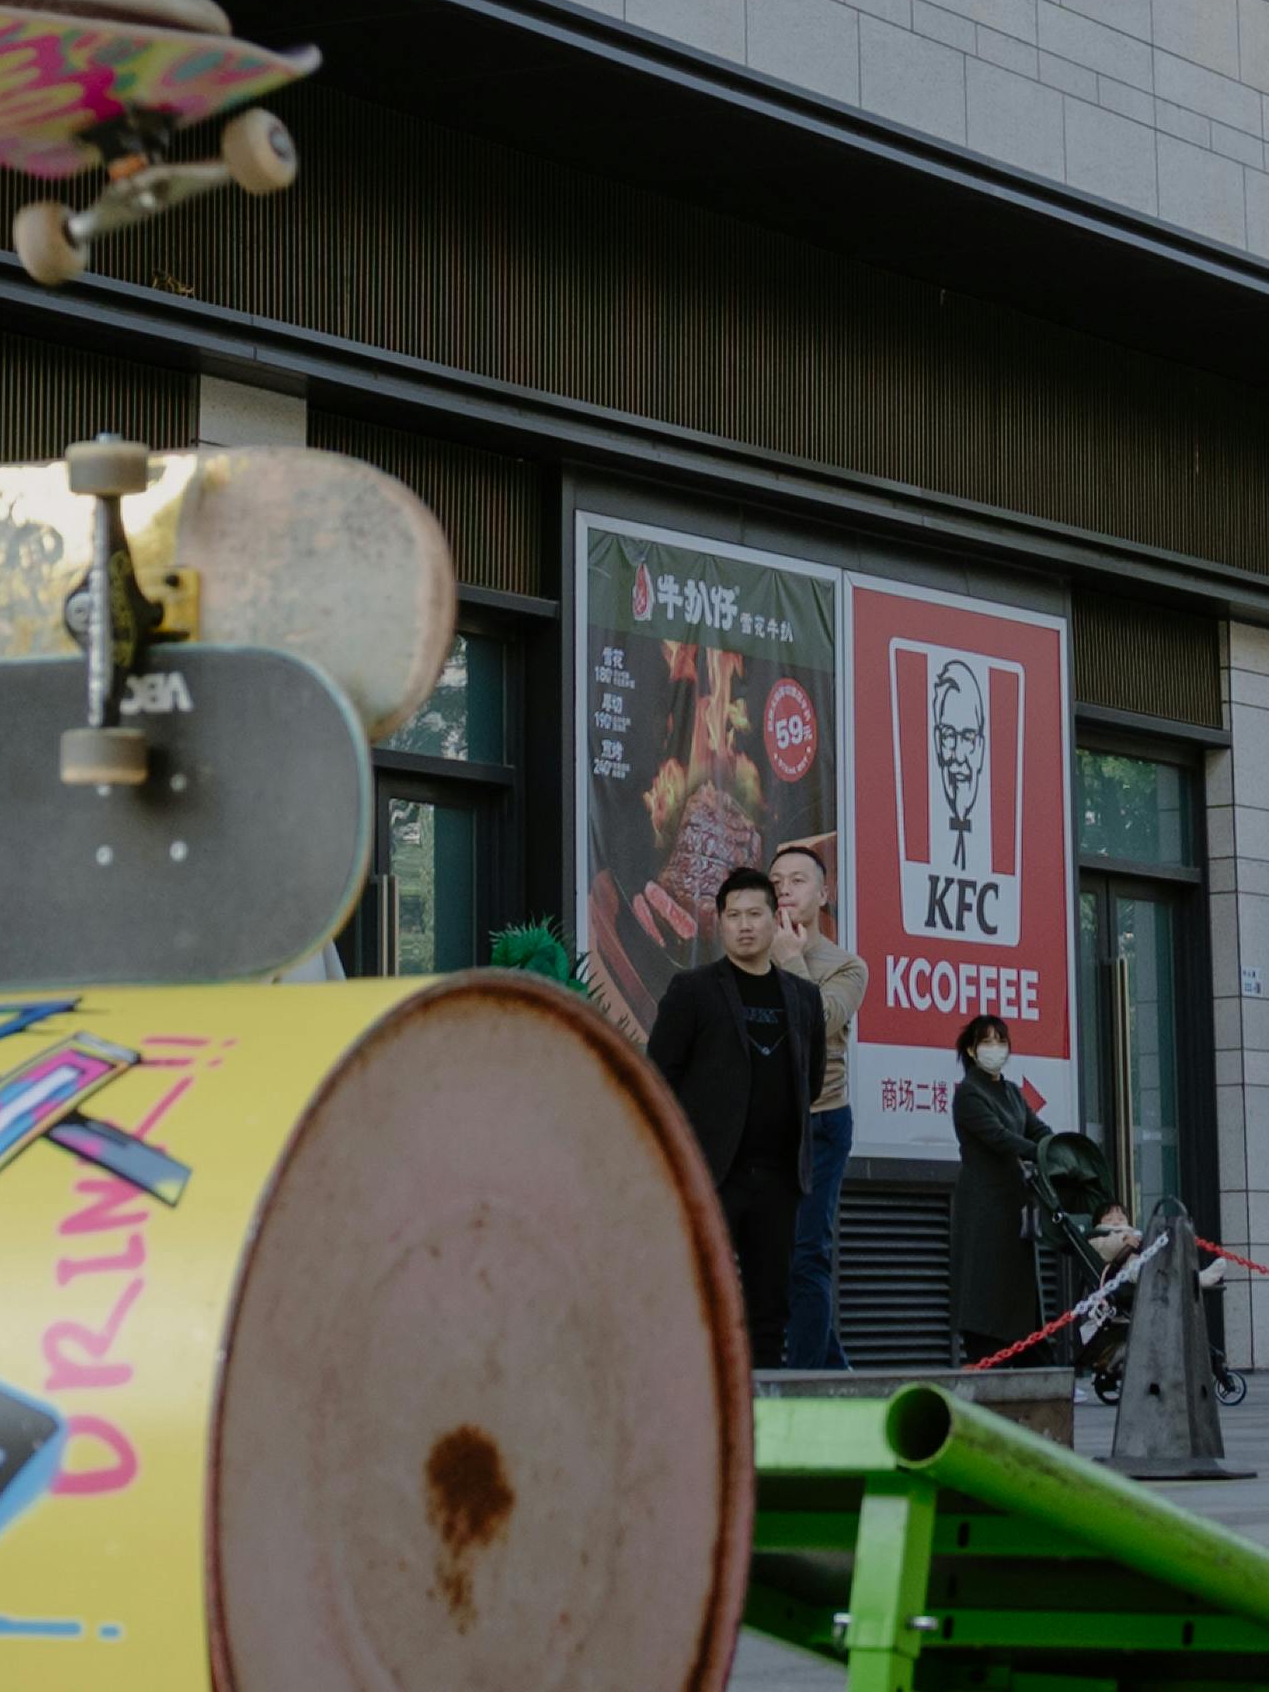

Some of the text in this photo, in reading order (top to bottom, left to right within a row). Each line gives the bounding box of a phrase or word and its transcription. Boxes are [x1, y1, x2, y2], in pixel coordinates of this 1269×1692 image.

[657, 574, 739, 631] 牛扒仔
[776, 714, 803, 749] 59
[924, 874, 999, 935] KFC
[886, 954, 1040, 1021] KCOFFEE
[881, 1077, 948, 1114] 商场二楼
